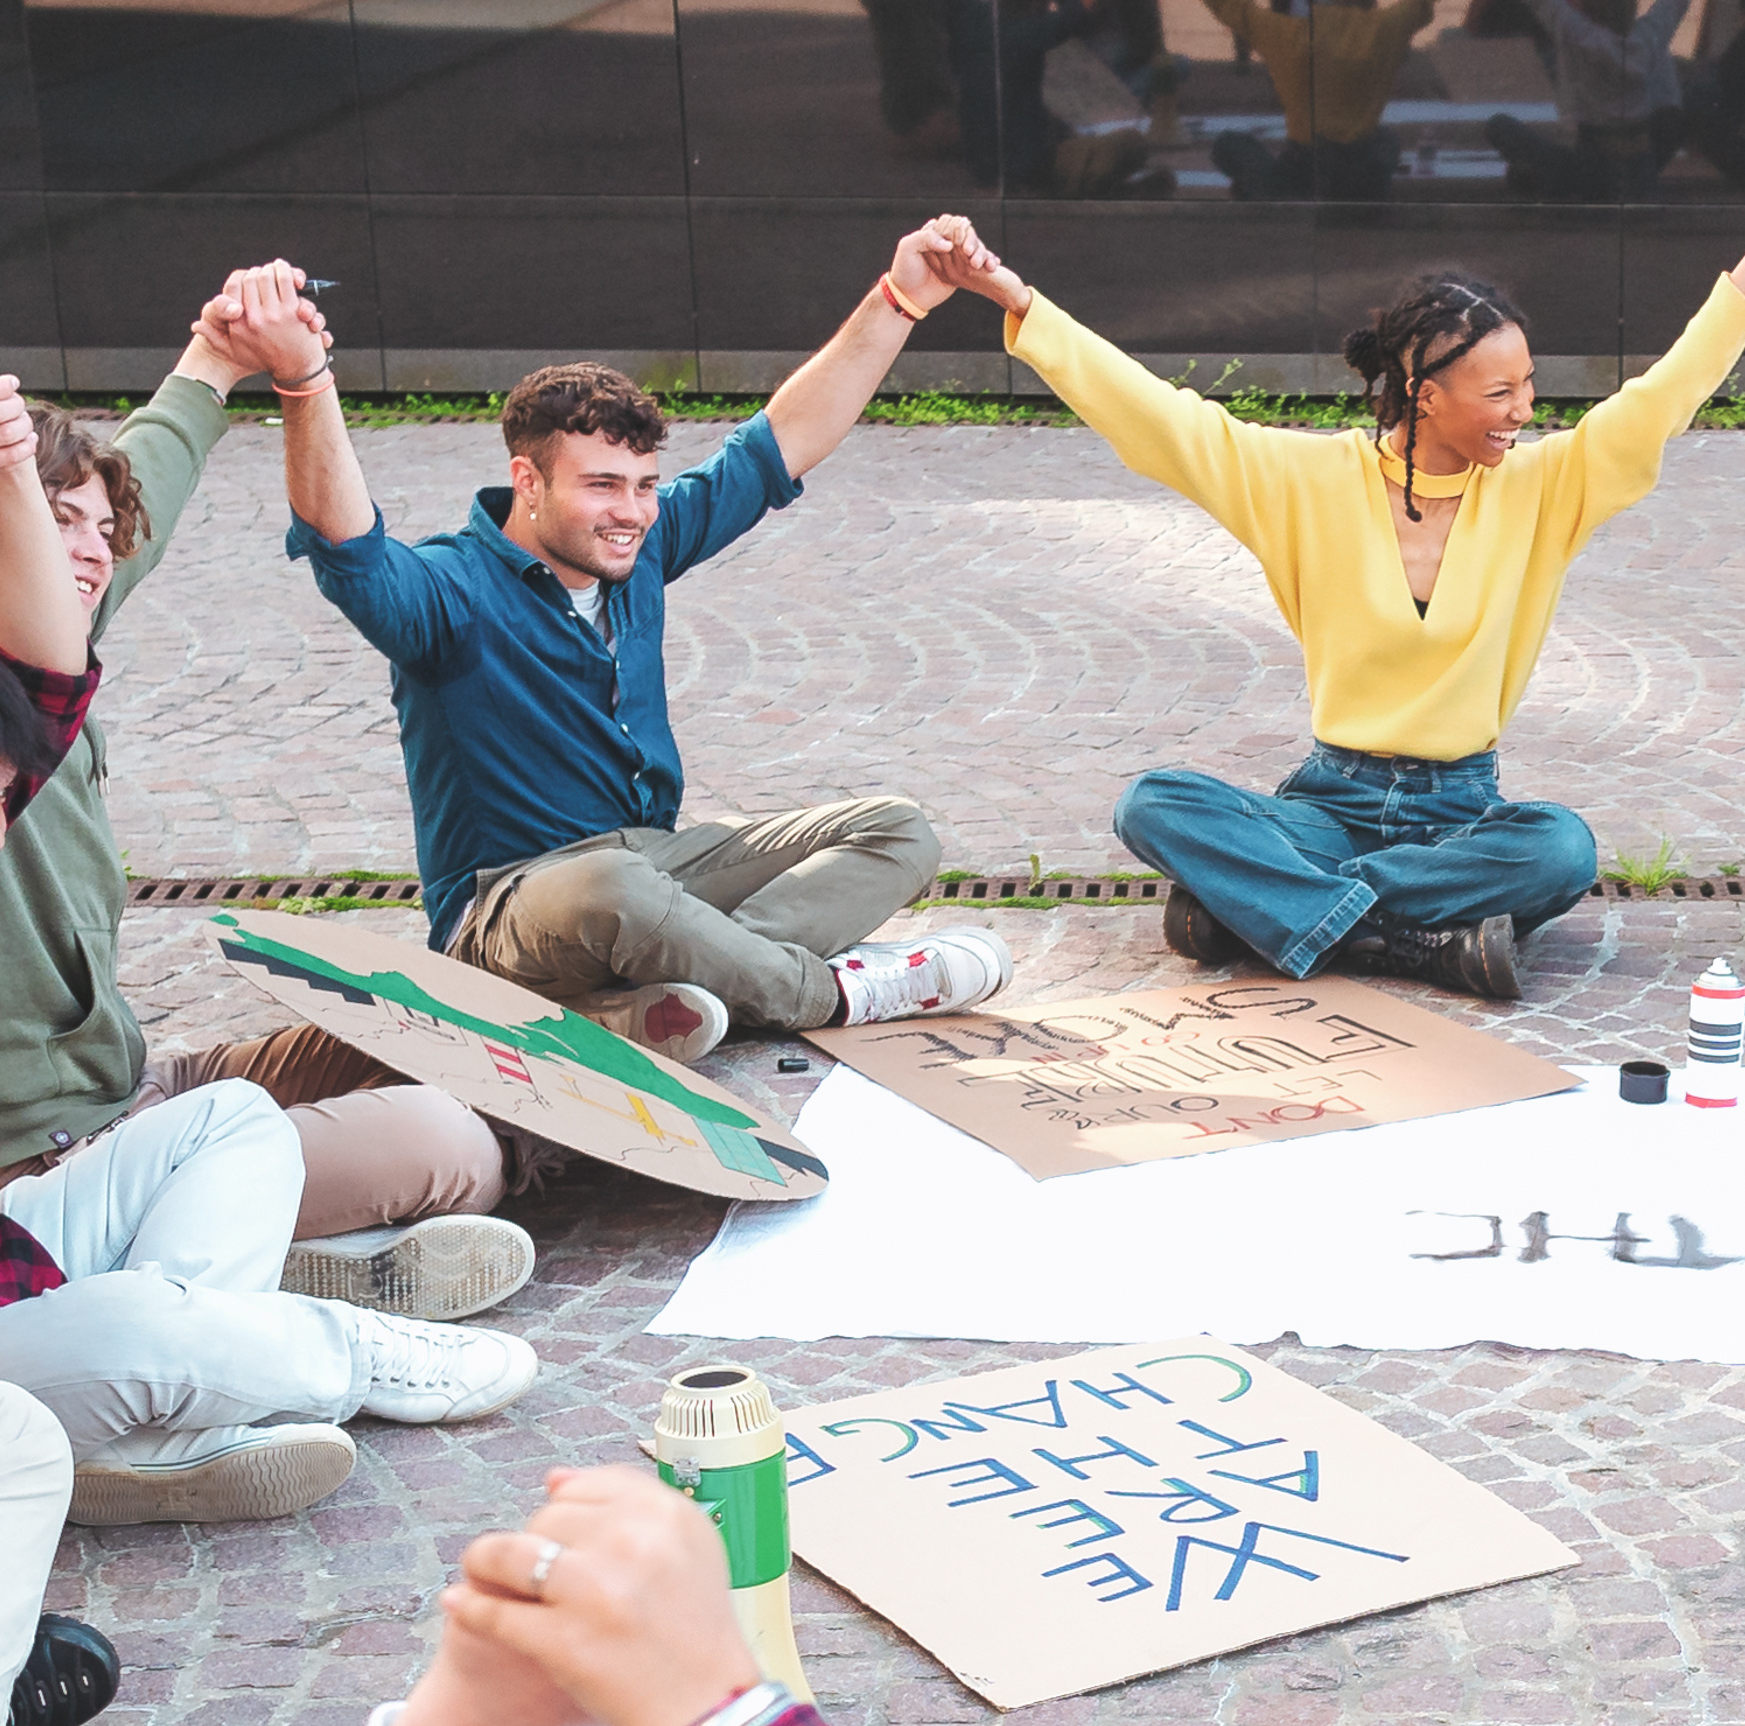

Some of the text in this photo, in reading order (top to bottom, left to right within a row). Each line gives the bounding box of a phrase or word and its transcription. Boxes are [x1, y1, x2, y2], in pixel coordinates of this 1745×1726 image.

[859, 987, 1318, 1069] SMOKE
[956, 1013, 1418, 1111] FUTURE
[1273, 1069, 1383, 1098] LET
[907, 1419, 1289, 1508] THE
[1011, 1450, 1319, 1550] ARE
[1042, 1521, 1411, 1613] WE
